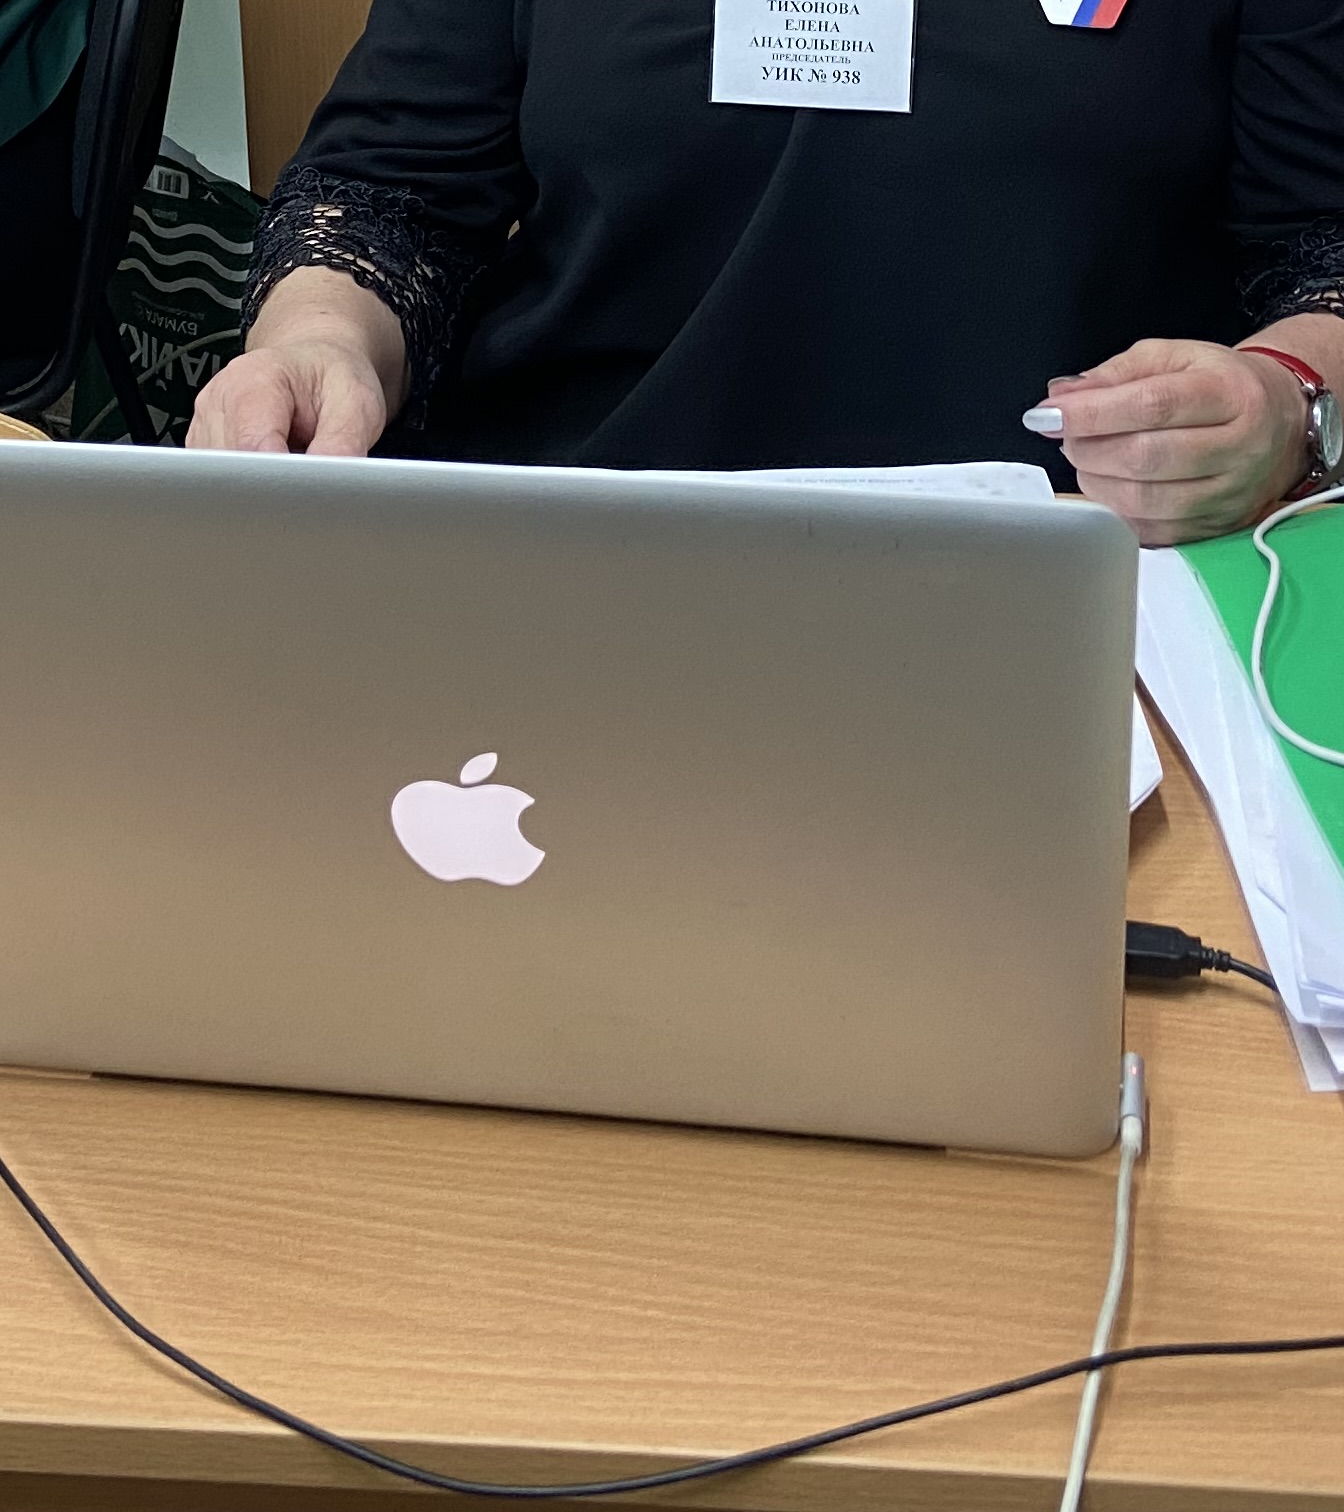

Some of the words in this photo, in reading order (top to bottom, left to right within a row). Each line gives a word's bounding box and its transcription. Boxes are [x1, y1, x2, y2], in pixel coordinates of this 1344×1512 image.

[766, 0, 860, 15] ТИХОНОВА
[785, 18, 840, 33] ЕЛЕНА
[749, 36, 875, 53] АНАТОЛЬЕВНА
[772, 53, 851, 64] ПРЕДСЕДАТЕЛЬ
[761, 66, 804, 82] УИК
[807, 68, 827, 83] №
[832, 70, 861, 85] 938
[119, 322, 221, 391] АЙК
